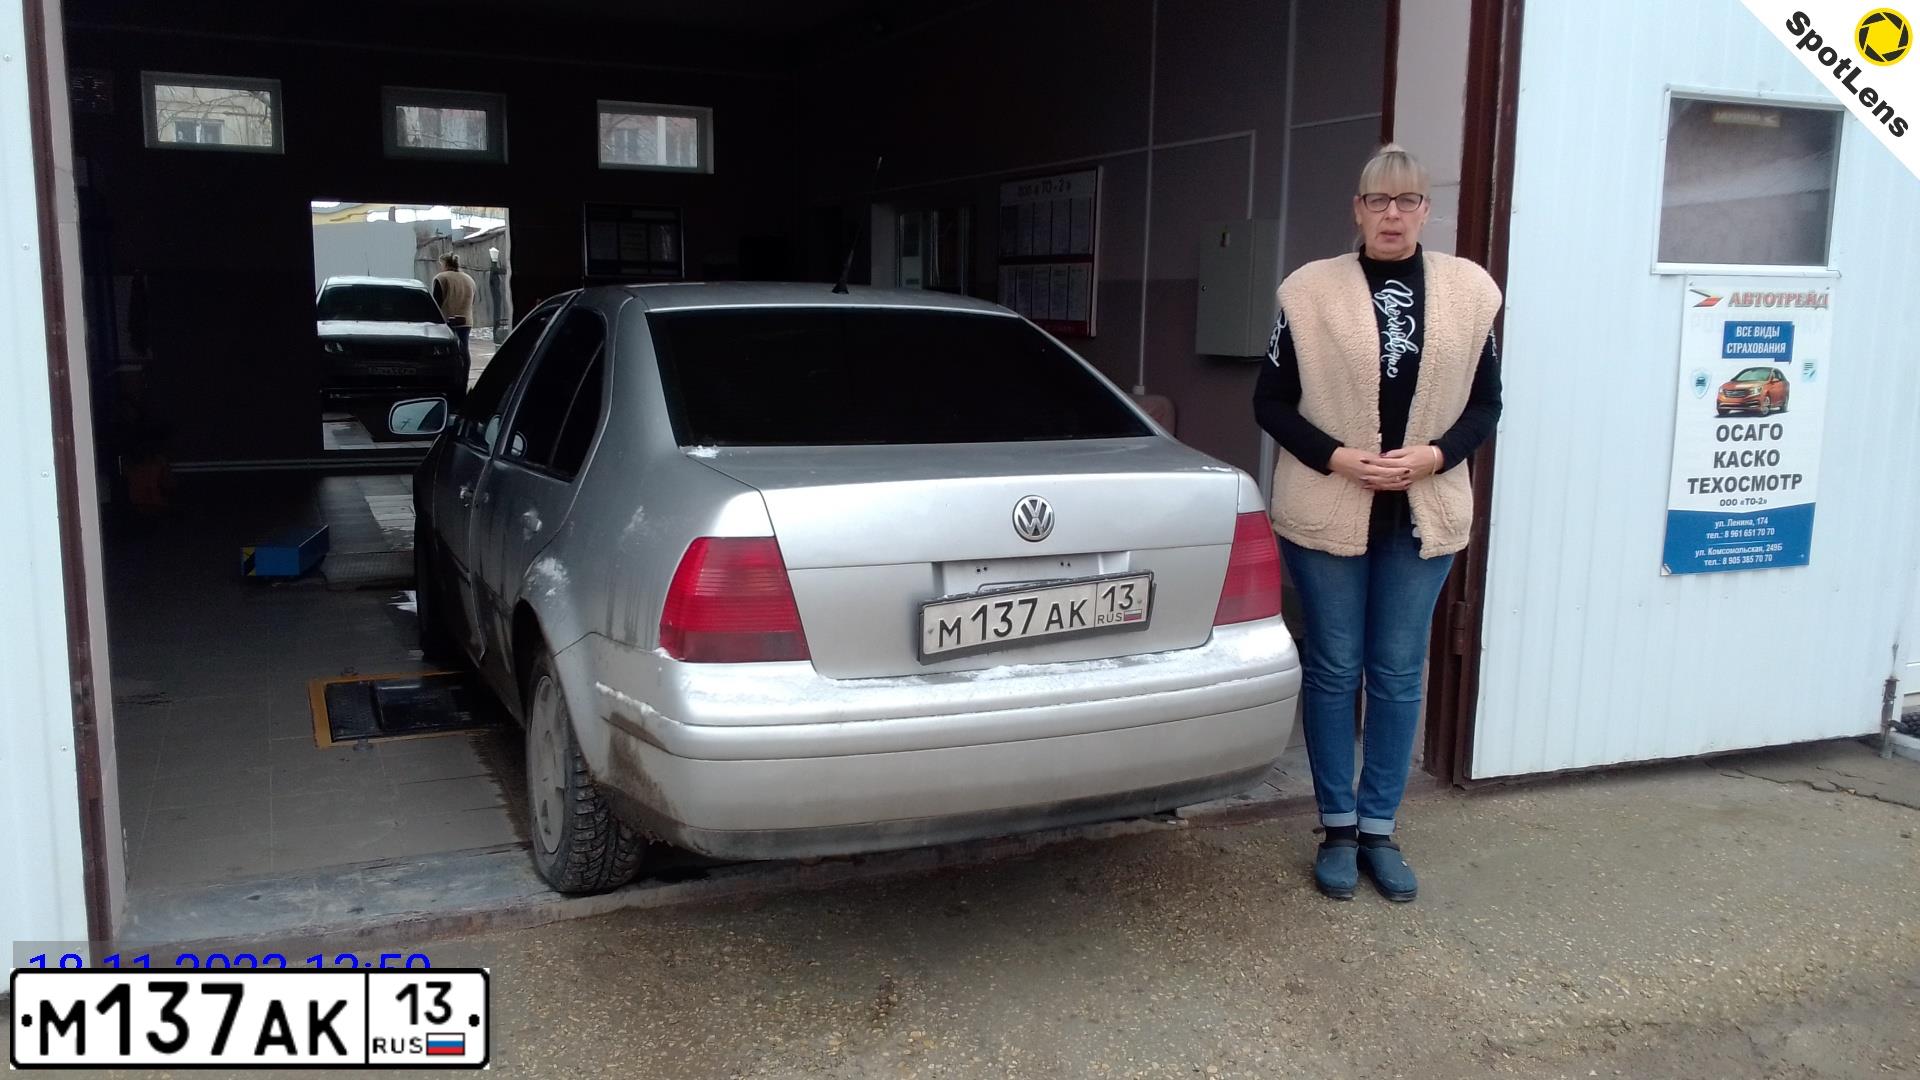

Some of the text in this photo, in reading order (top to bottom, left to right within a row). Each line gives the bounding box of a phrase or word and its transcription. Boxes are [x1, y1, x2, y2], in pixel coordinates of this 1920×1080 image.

[1728, 291, 1829, 310] АВТОТРЕЙД
[1736, 325, 1780, 339] ВСЕ ВИДЫ
[1727, 342, 1786, 354] СТРАХОВАНИЯ
[1716, 423, 1783, 442] ОСАГО
[1714, 449, 1780, 468] КАСКО
[1687, 473, 1802, 494] ТЕХОСМОТР
[1720, 497, 1767, 507] ООО «ТО-2»
[1714, 517, 1768, 529] ул. Ленина, 174
[1744, 529, 1755, 537] 651
[1758, 528, 1765, 536] 70
[1767, 528, 1775, 536] 70
[1695, 543, 1783, 558] ул. Комсомольская, 249Б
[1722, 557, 1727, 565] 8
[1755, 555, 1763, 563] 70
[1765, 554, 1773, 562] 70
[1102, 583, 1135, 612] 13
[1097, 612, 1123, 625] RUS
